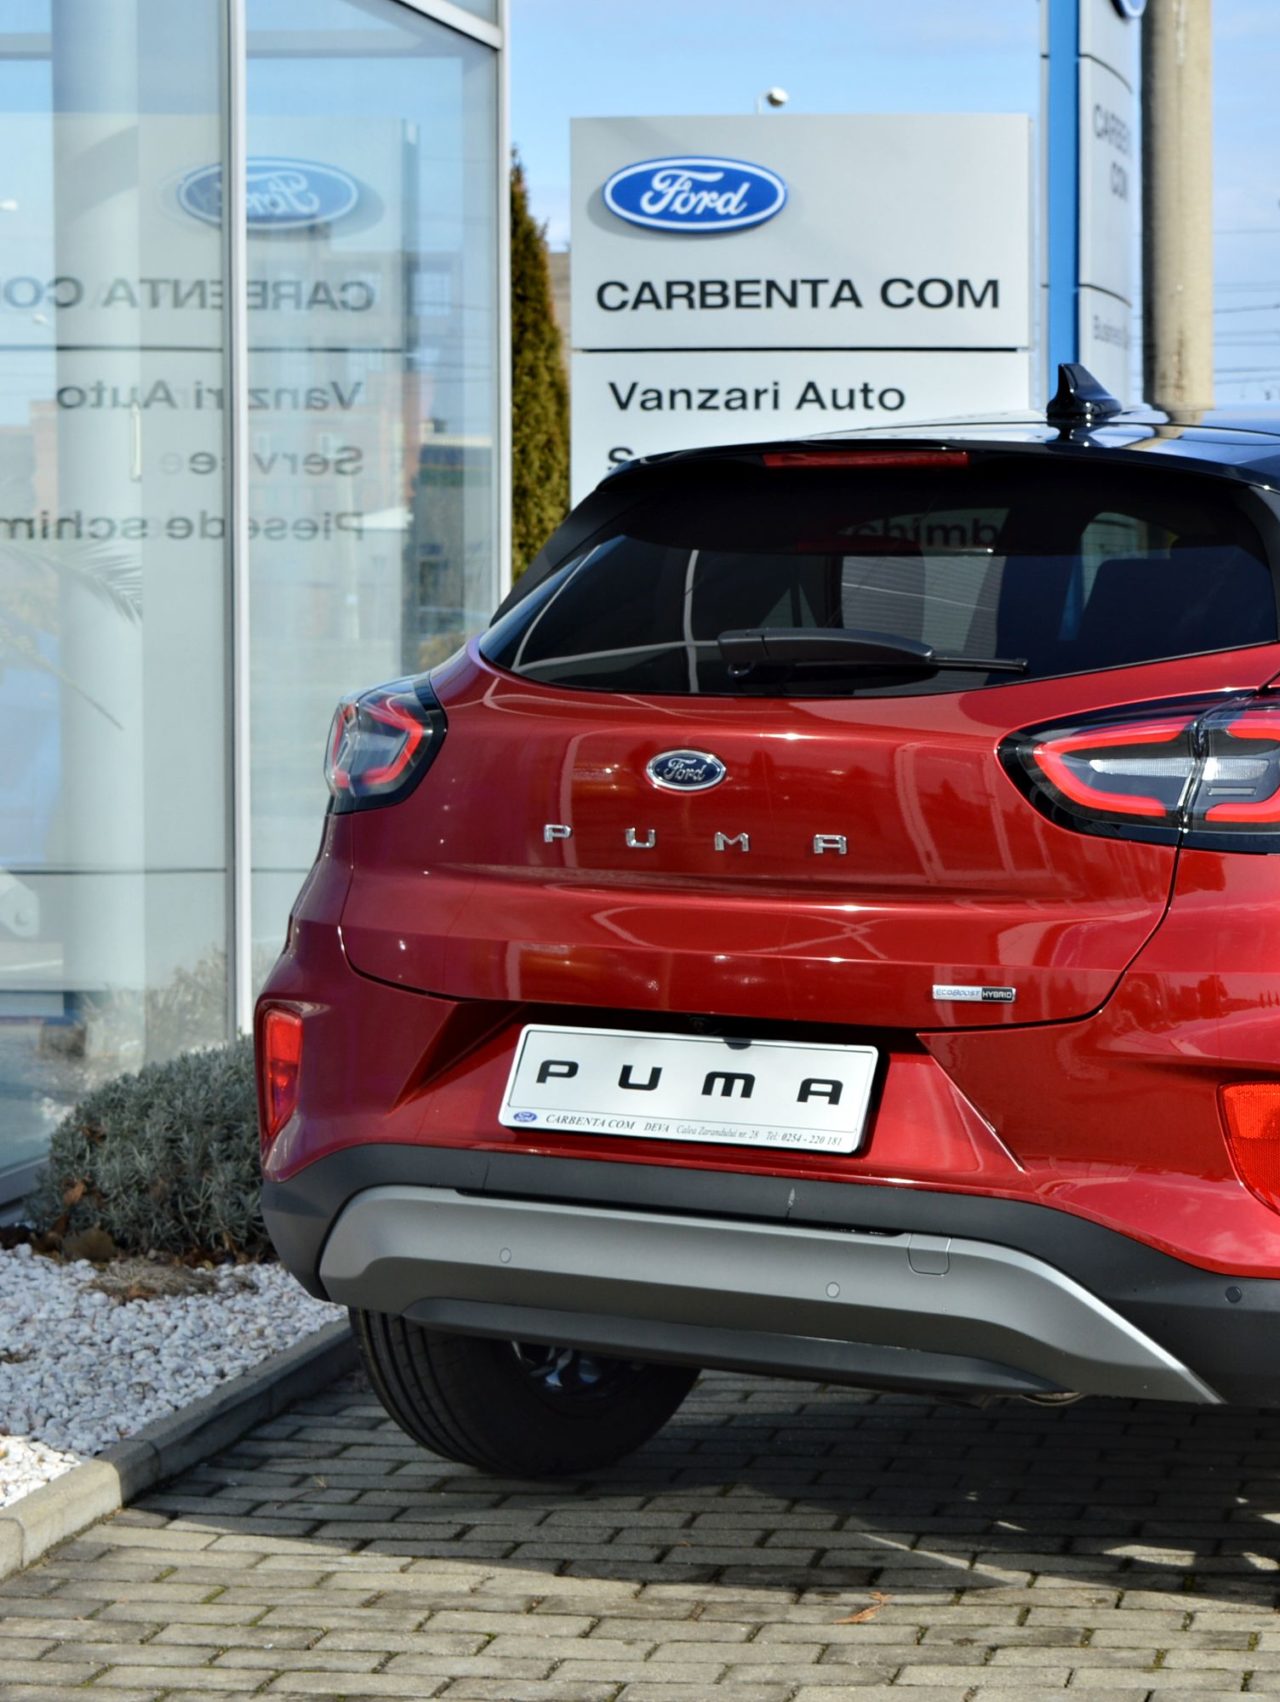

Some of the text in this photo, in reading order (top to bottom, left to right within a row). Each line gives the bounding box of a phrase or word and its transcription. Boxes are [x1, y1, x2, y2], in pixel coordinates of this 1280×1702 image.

[640, 168, 750, 216] Ford
[596, 278, 999, 312] CARBENTA COM
[609, 381, 905, 412] Vanzari Auto
[663, 758, 706, 784] Ford
[543, 824, 848, 854] PUMA
[982, 989, 1012, 999] HYBRID
[536, 1059, 843, 1105] PUMA
[546, 1114, 606, 1129] CARBENTA
[608, 1119, 635, 1130] COM
[644, 1122, 670, 1133] DEVA
[781, 1132, 802, 1143] 0254
[808, 1134, 825, 1145] 220
